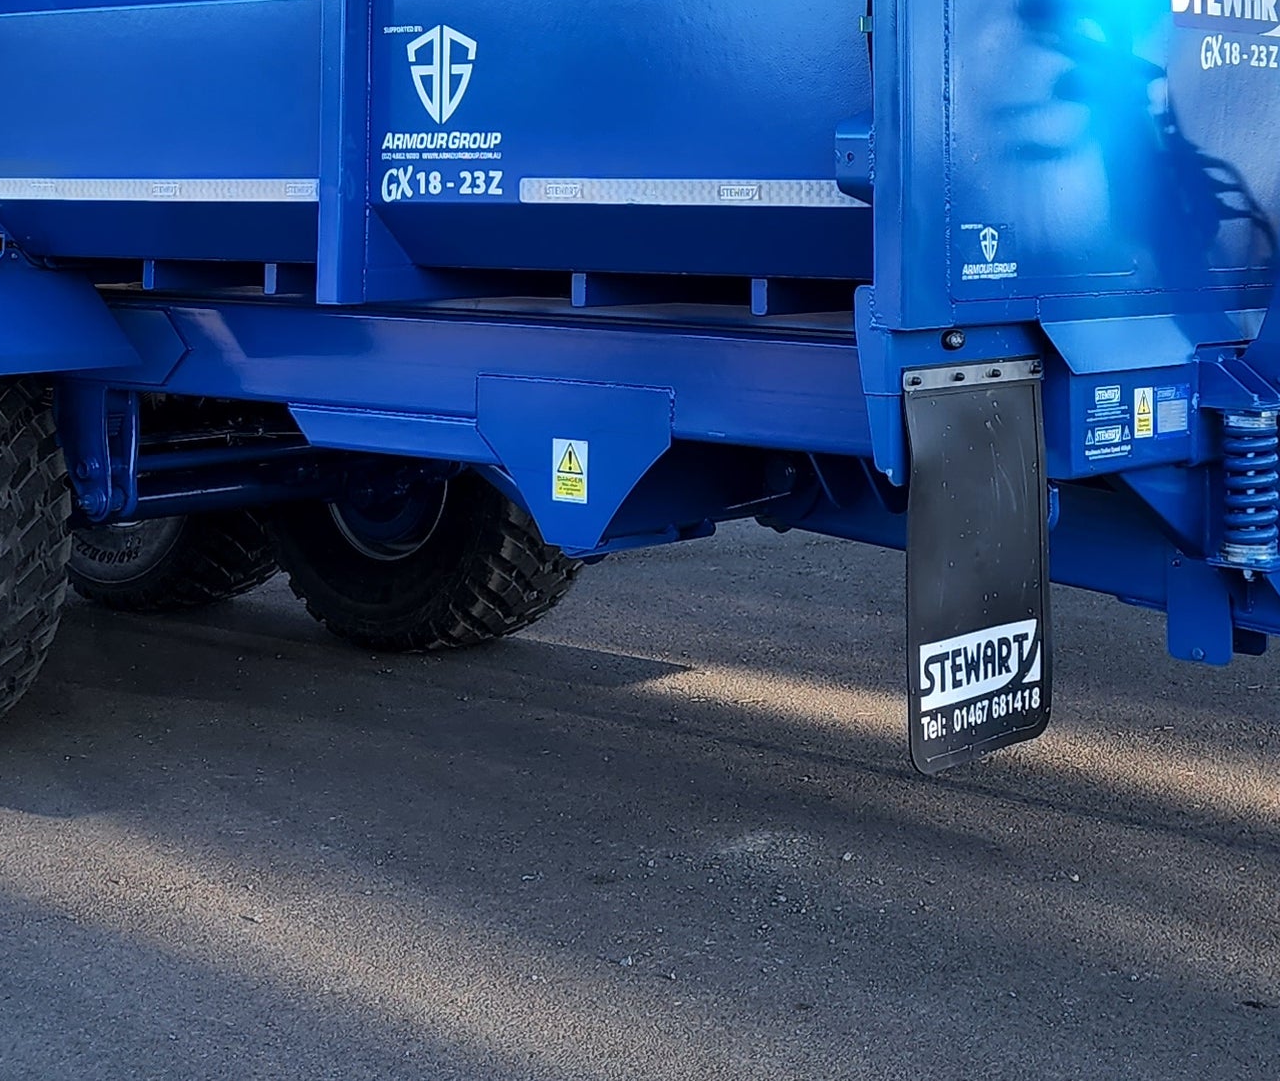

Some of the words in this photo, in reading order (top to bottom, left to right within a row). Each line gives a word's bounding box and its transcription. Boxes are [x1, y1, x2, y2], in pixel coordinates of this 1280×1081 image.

[381, 132, 448, 150] ARMOUR
[448, 131, 502, 149] GROUP
[920, 622, 1039, 699] STEWART
[921, 713, 946, 741] Tel:
[953, 699, 990, 732] 01467
[991, 686, 1040, 719] 681418
